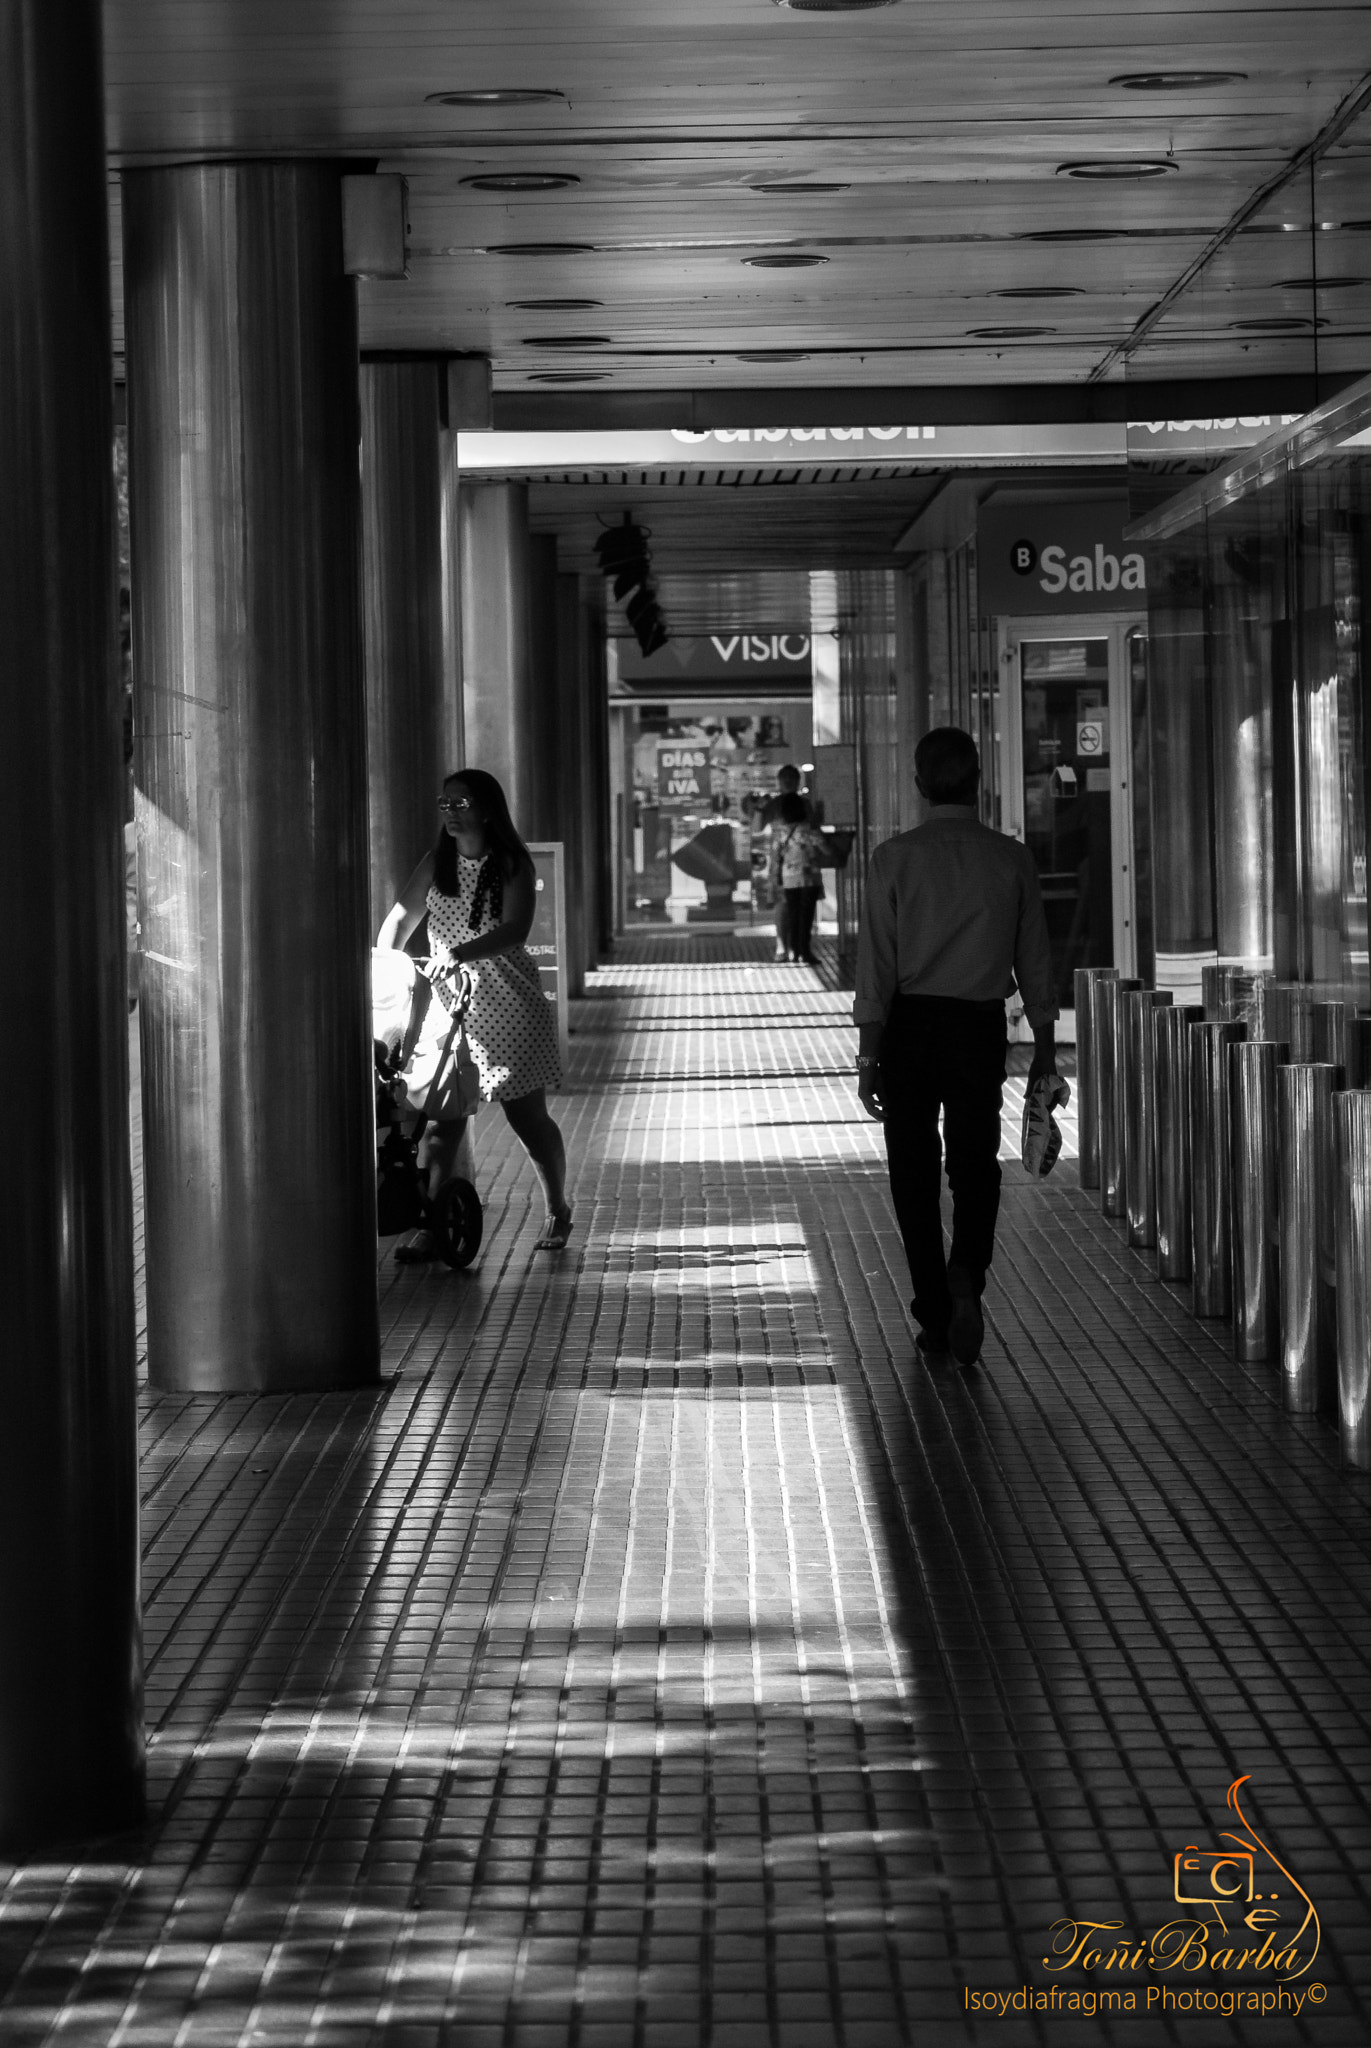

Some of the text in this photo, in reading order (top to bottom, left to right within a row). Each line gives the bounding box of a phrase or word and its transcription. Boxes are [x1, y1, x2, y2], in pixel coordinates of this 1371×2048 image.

[1017, 543, 1146, 594] B Saba
[710, 634, 810, 662] VISIO
[668, 779, 700, 794] IVA
